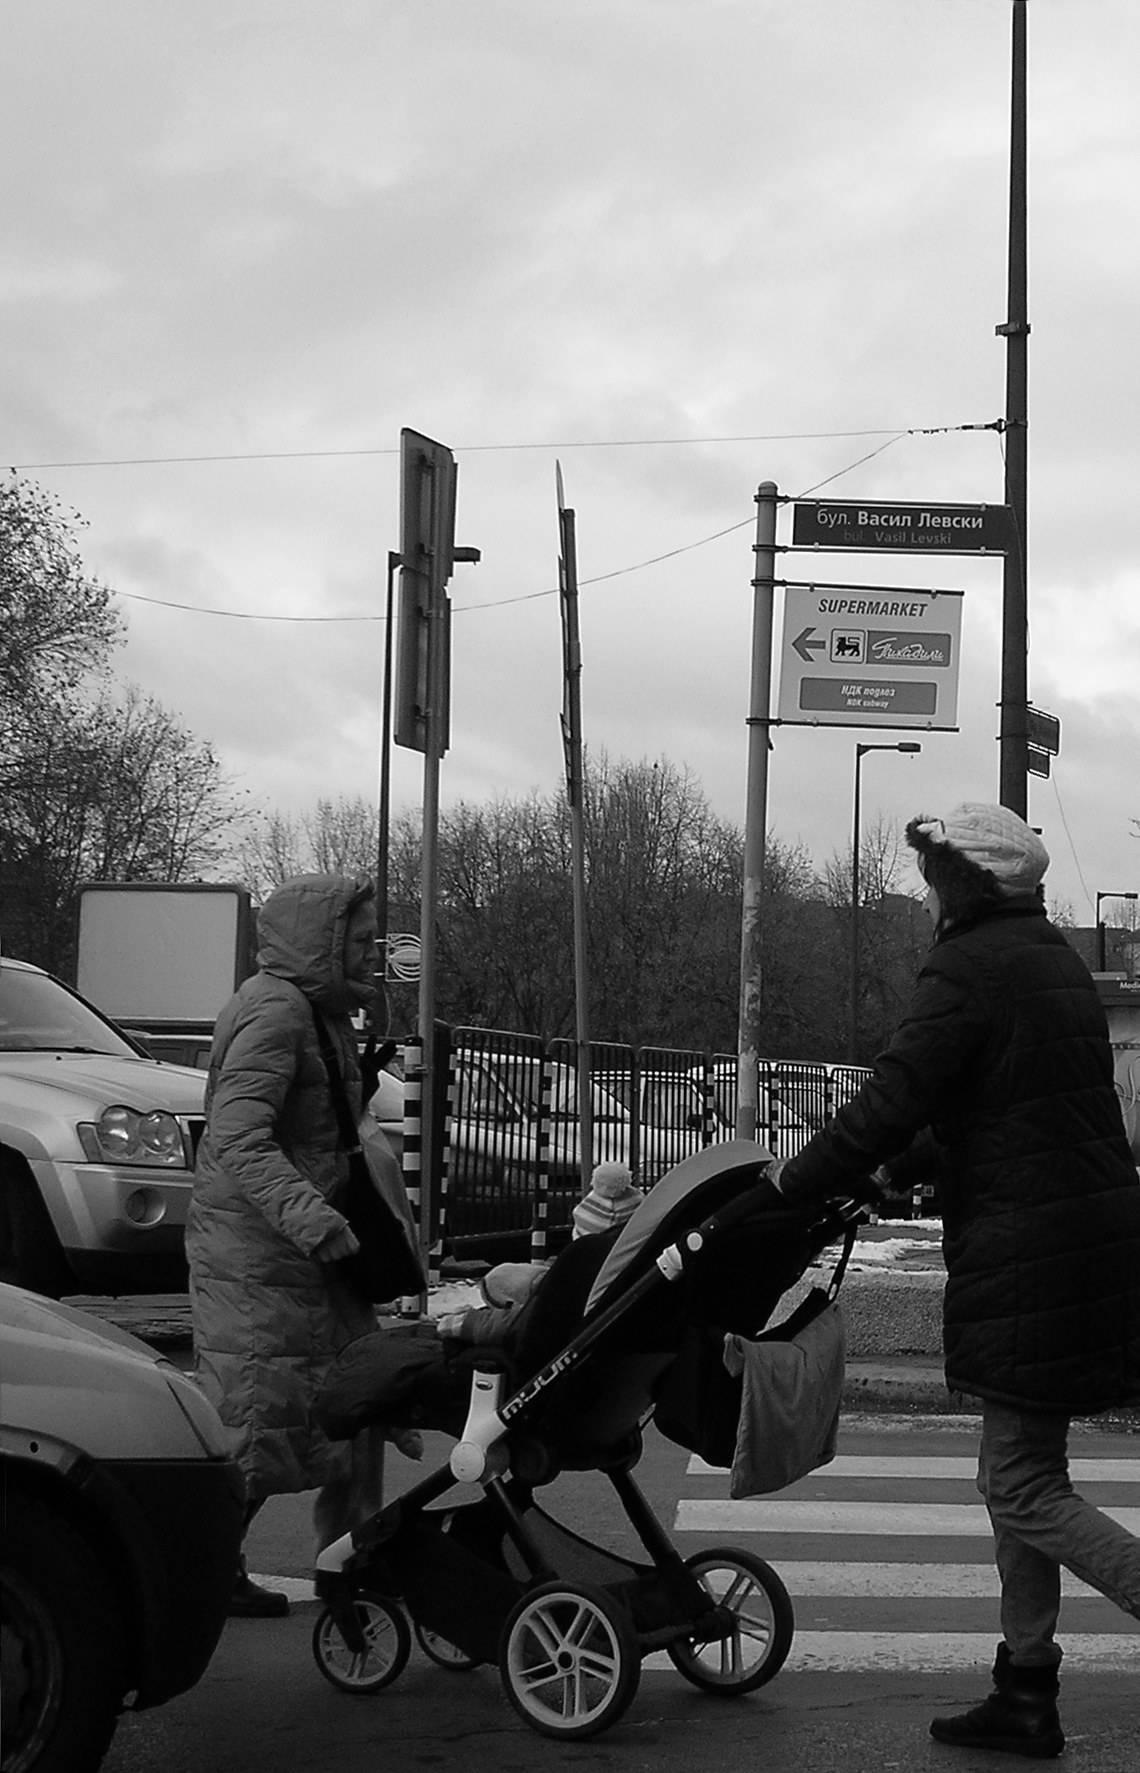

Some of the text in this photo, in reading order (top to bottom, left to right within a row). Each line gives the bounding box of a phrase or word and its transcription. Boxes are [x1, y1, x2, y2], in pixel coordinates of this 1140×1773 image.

[817, 509, 983, 529] бул. Васил Левски
[875, 531, 905, 543] Vasil
[911, 532, 951, 544] Levski
[818, 599, 928, 617] SUPERMARKET
[841, 685, 862, 697] НДК
